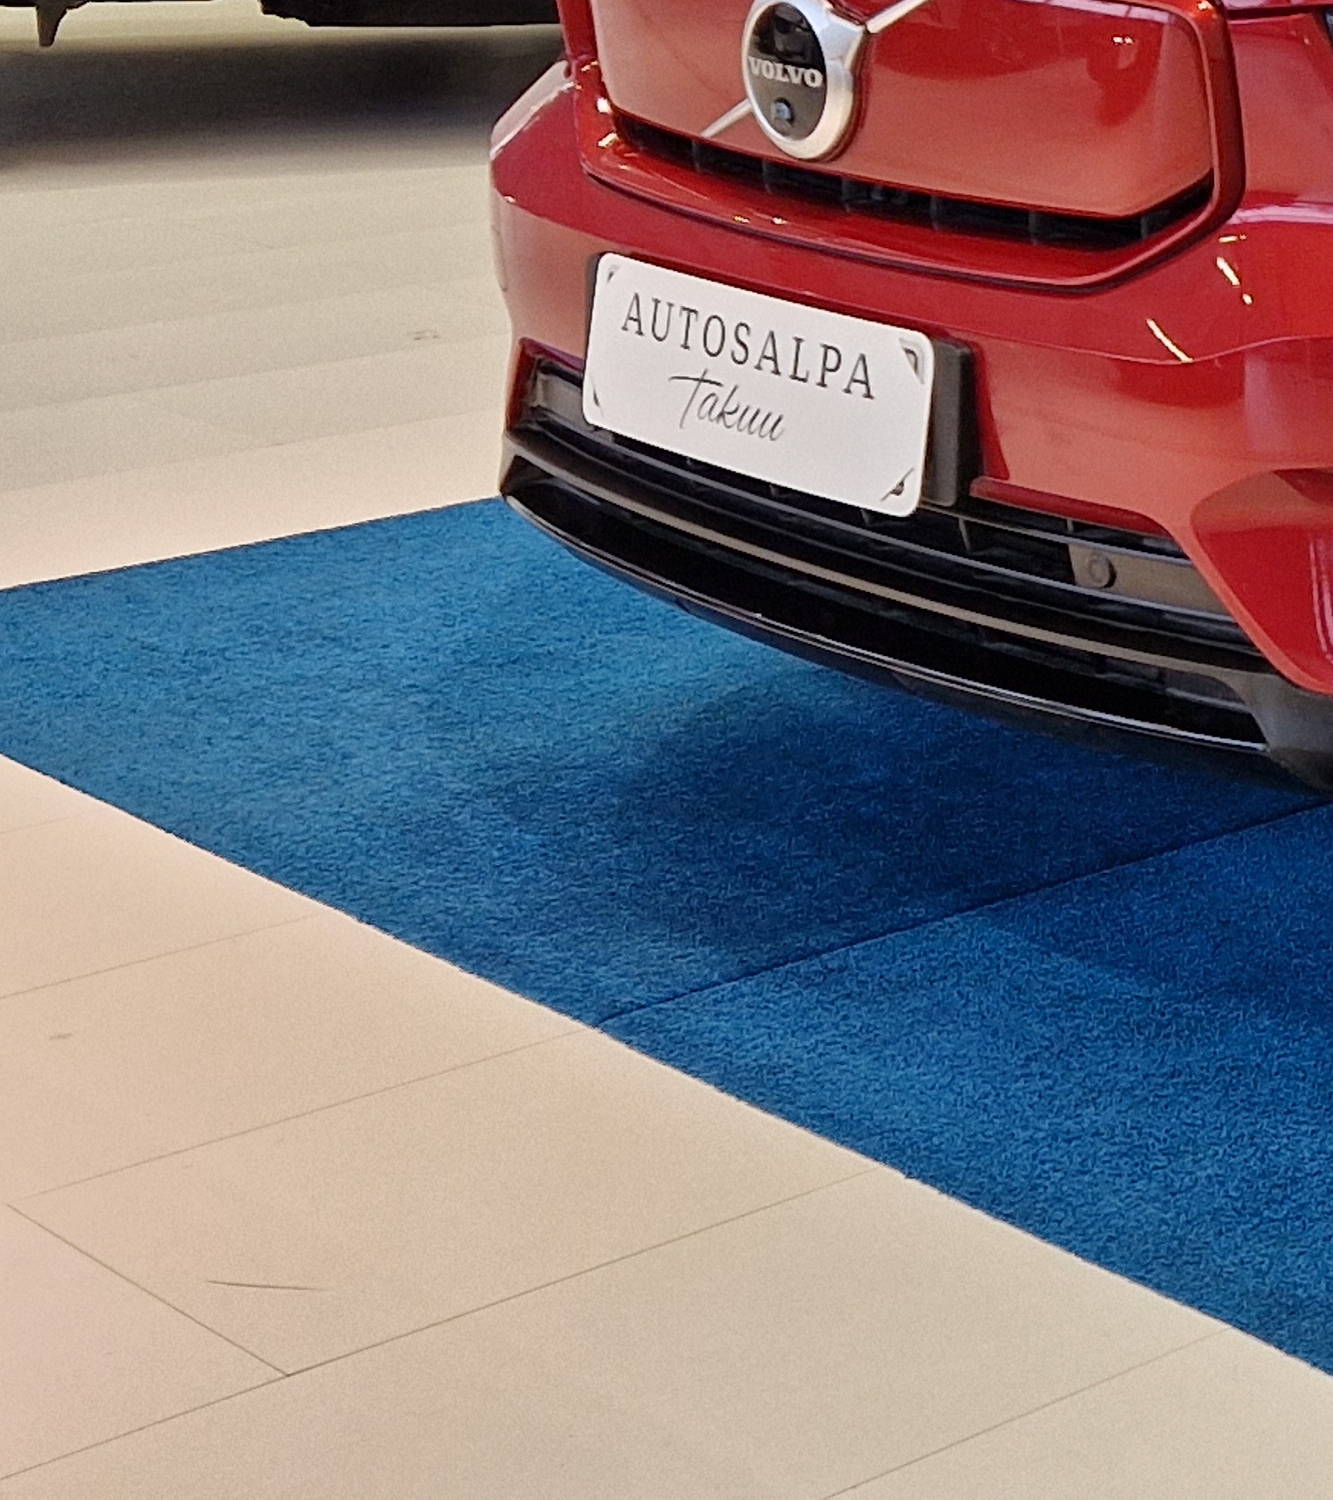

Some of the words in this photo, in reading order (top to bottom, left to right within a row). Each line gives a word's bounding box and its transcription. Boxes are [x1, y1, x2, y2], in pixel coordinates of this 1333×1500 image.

[747, 56, 823, 87] VOLVO
[620, 292, 875, 400] AUTOSALPA
[668, 369, 784, 442] Takuu
